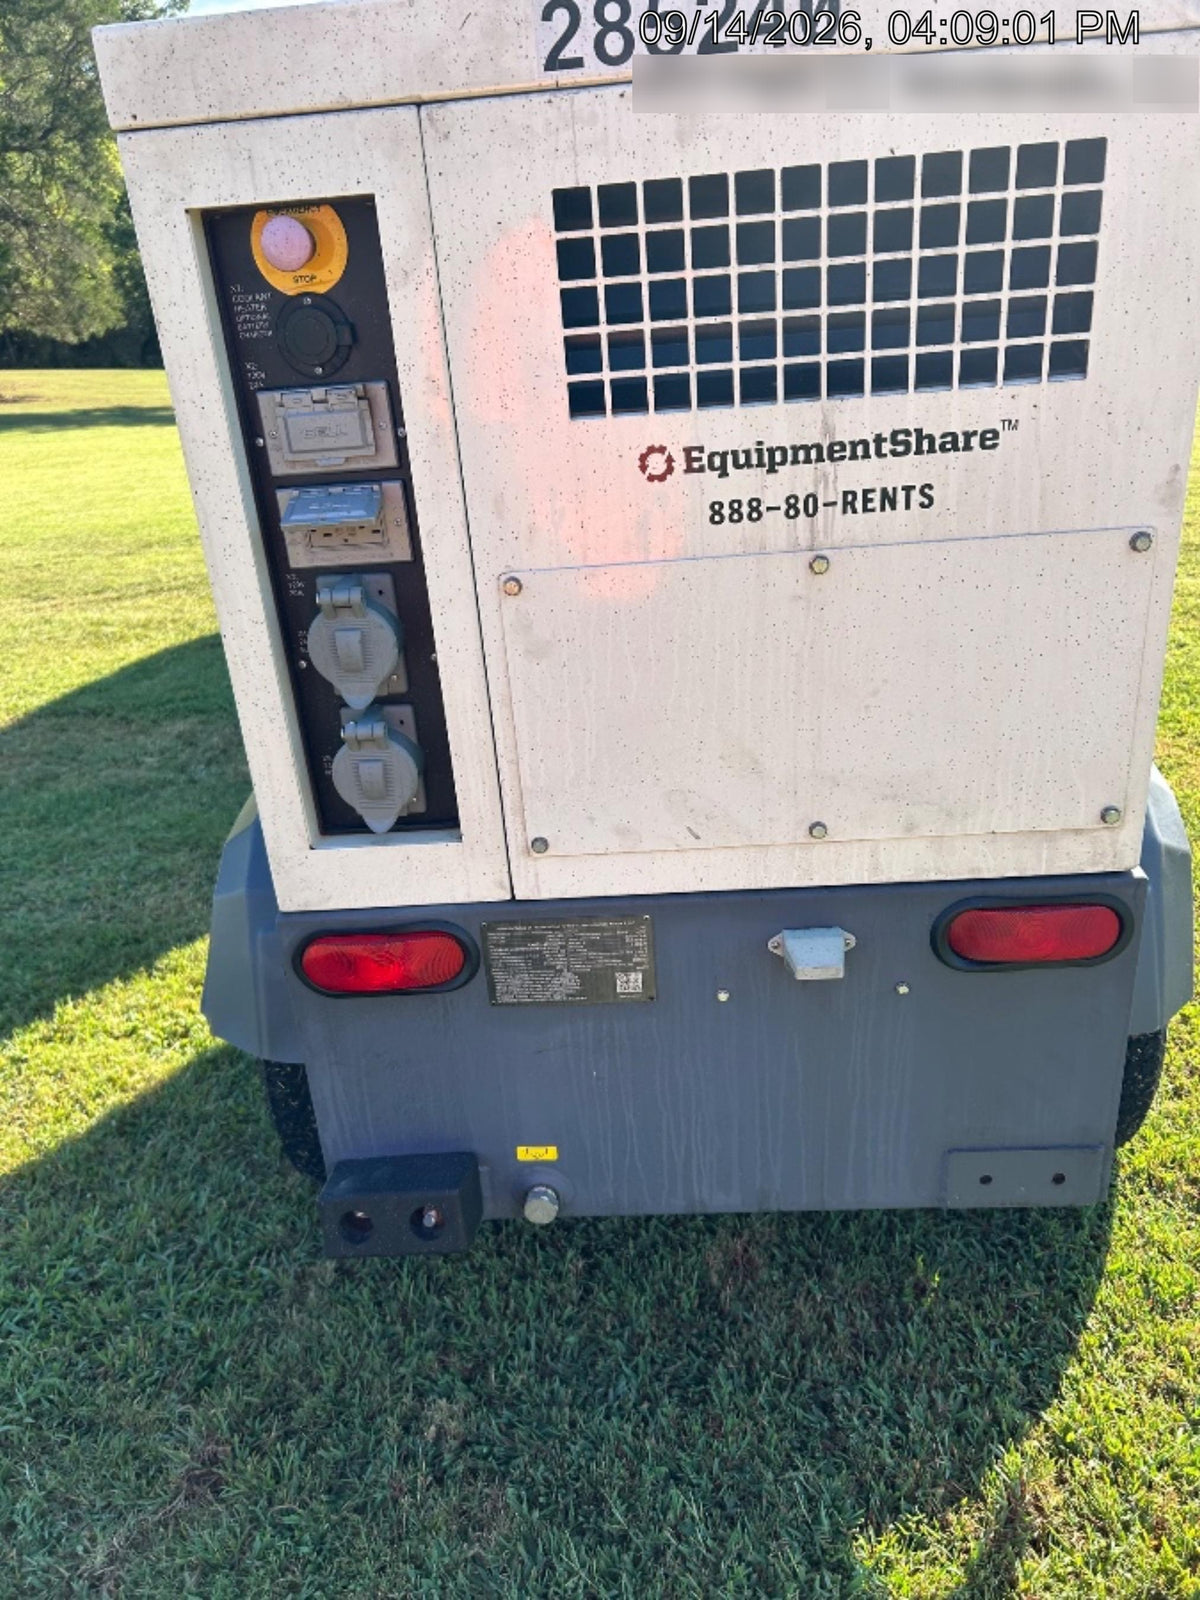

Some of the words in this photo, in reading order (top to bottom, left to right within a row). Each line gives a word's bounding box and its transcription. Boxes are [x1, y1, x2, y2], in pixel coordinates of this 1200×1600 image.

[292, 274, 317, 284] STOP
[683, 426, 1000, 478] EquipmentShare
[708, 482, 935, 526] 888-80-RENTS
